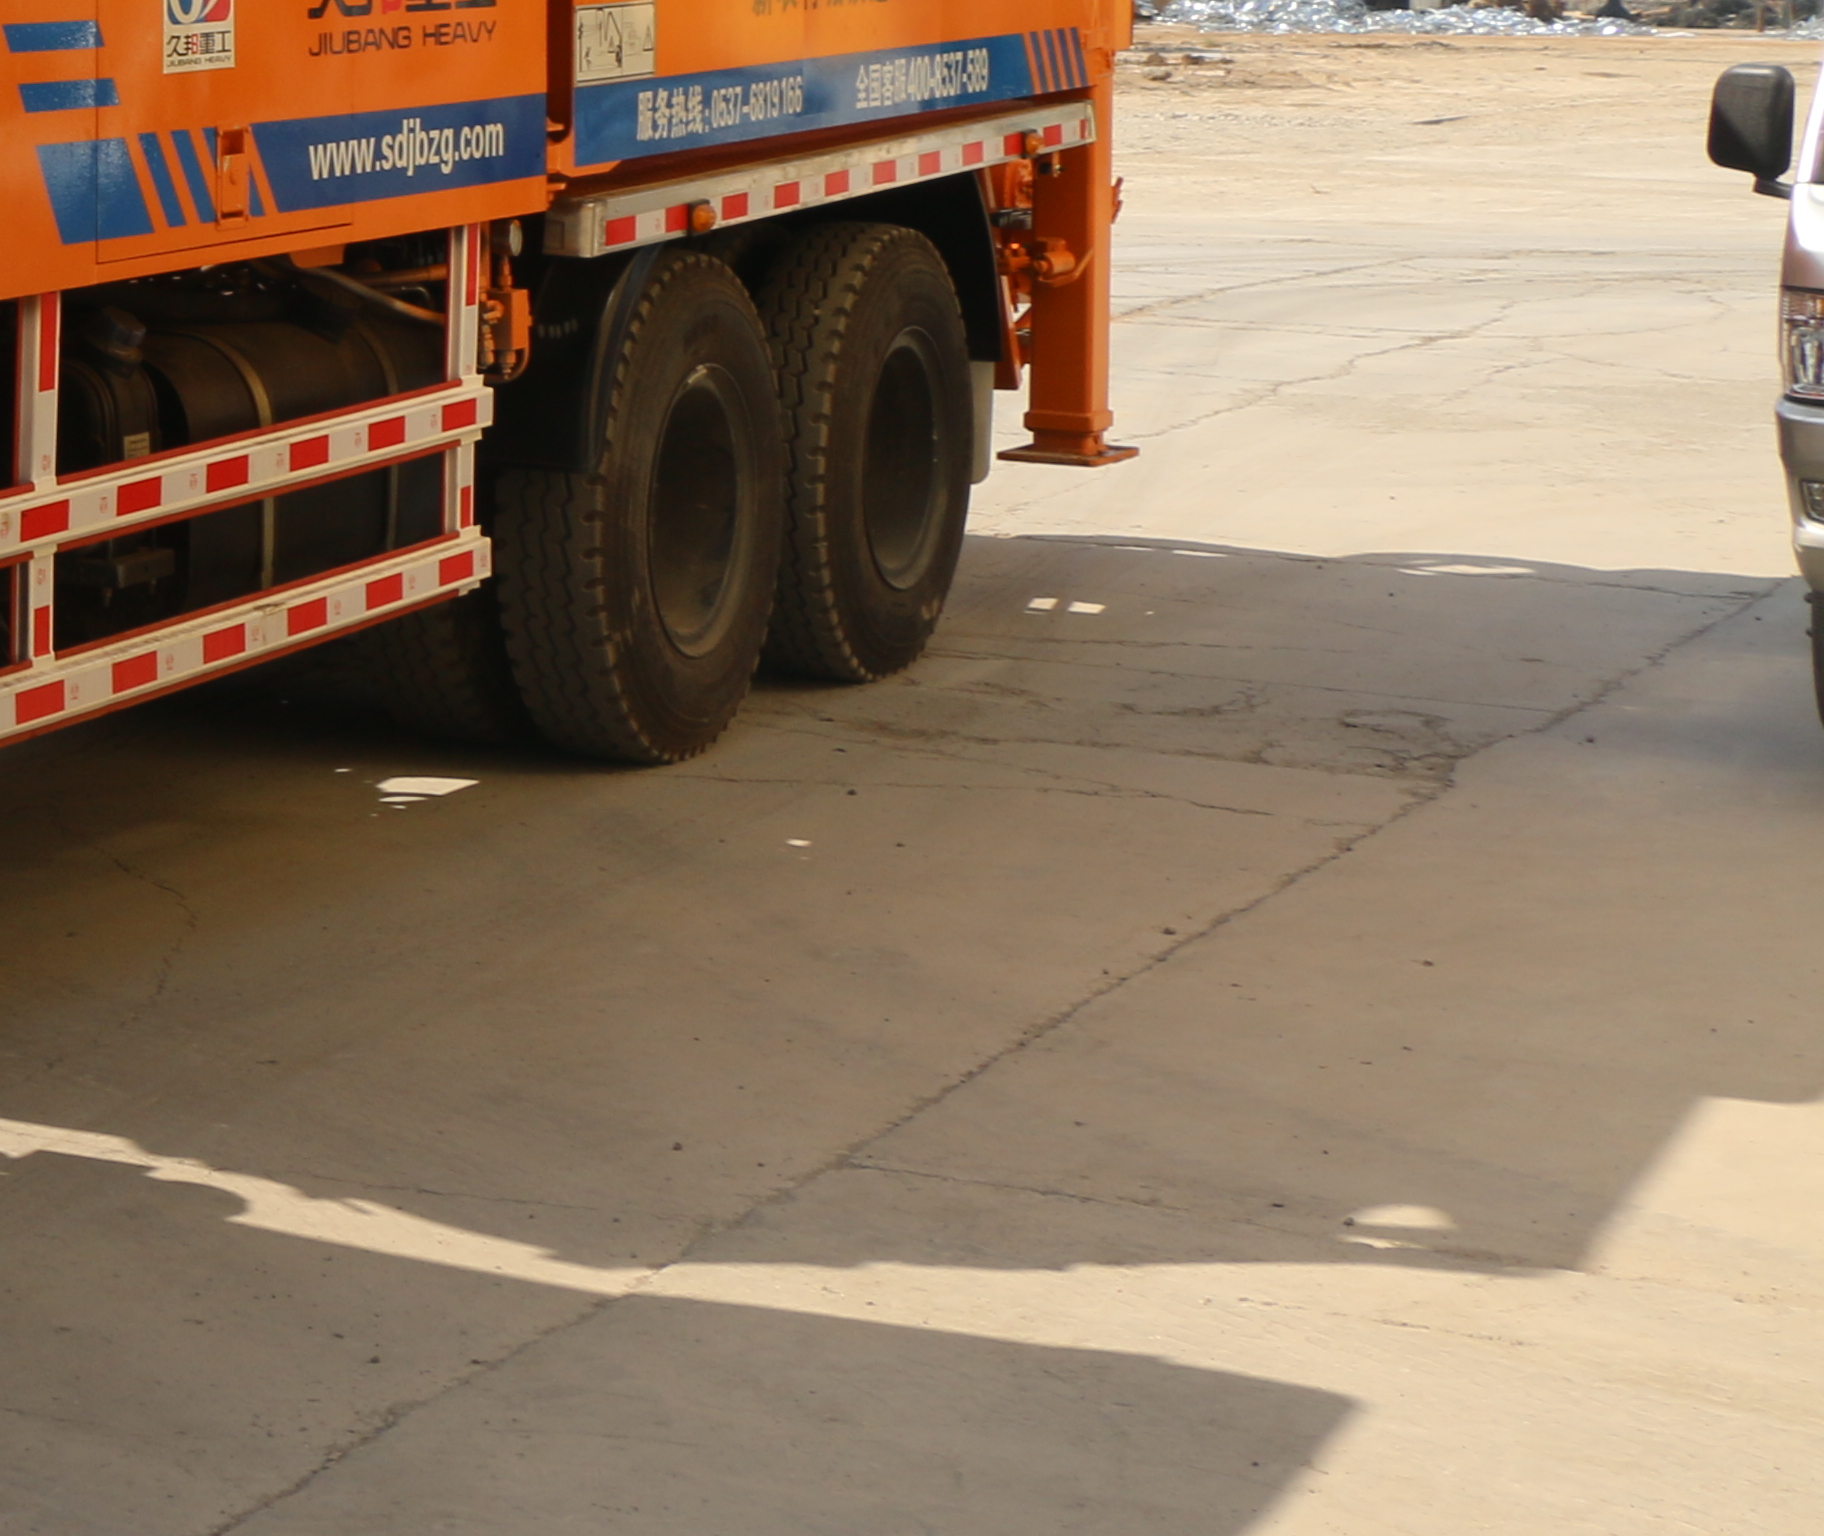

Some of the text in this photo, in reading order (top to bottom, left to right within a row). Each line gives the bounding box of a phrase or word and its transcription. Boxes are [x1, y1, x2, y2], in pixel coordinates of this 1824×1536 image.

[166, 30, 232, 58] 久邦重工
[309, 20, 497, 57] JIUBANG HEAVY
[308, 117, 505, 181] www.sdjbzg.com
